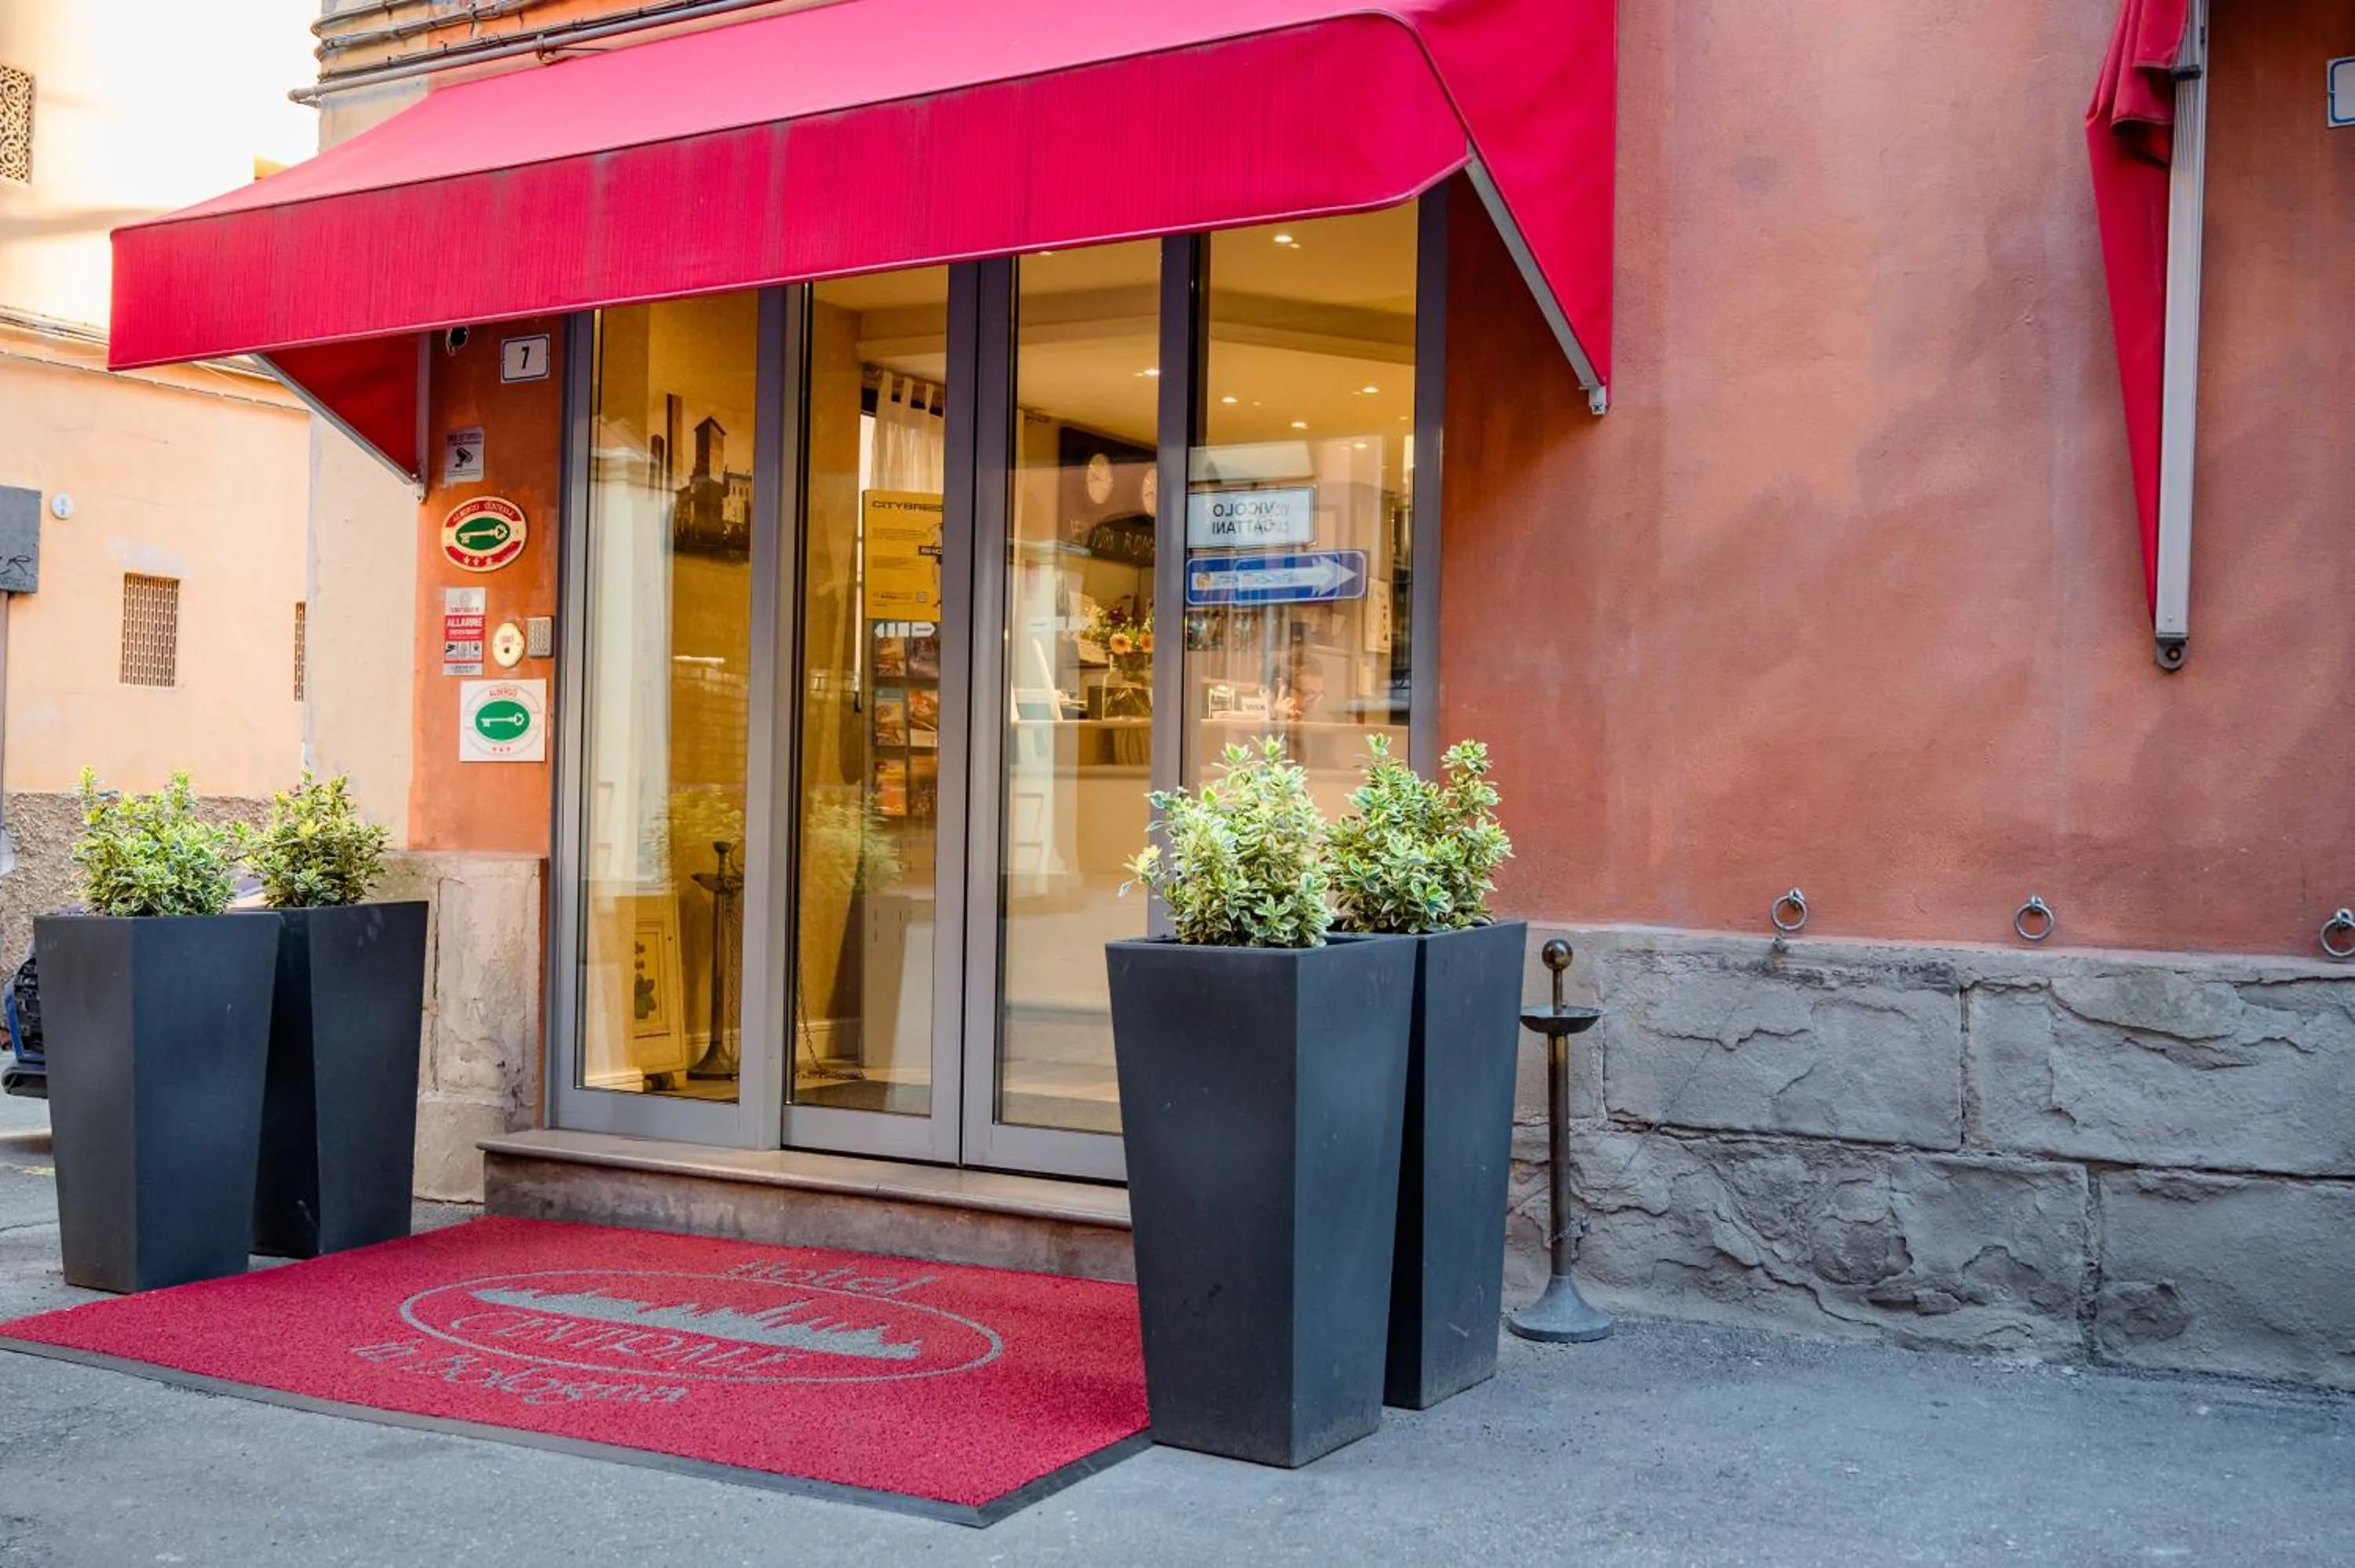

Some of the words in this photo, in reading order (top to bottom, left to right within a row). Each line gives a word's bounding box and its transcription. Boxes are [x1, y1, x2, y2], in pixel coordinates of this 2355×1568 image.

[520, 346, 530, 370] 7
[447, 617, 484, 628] ALLARME
[725, 1257, 939, 1297] Hotel
